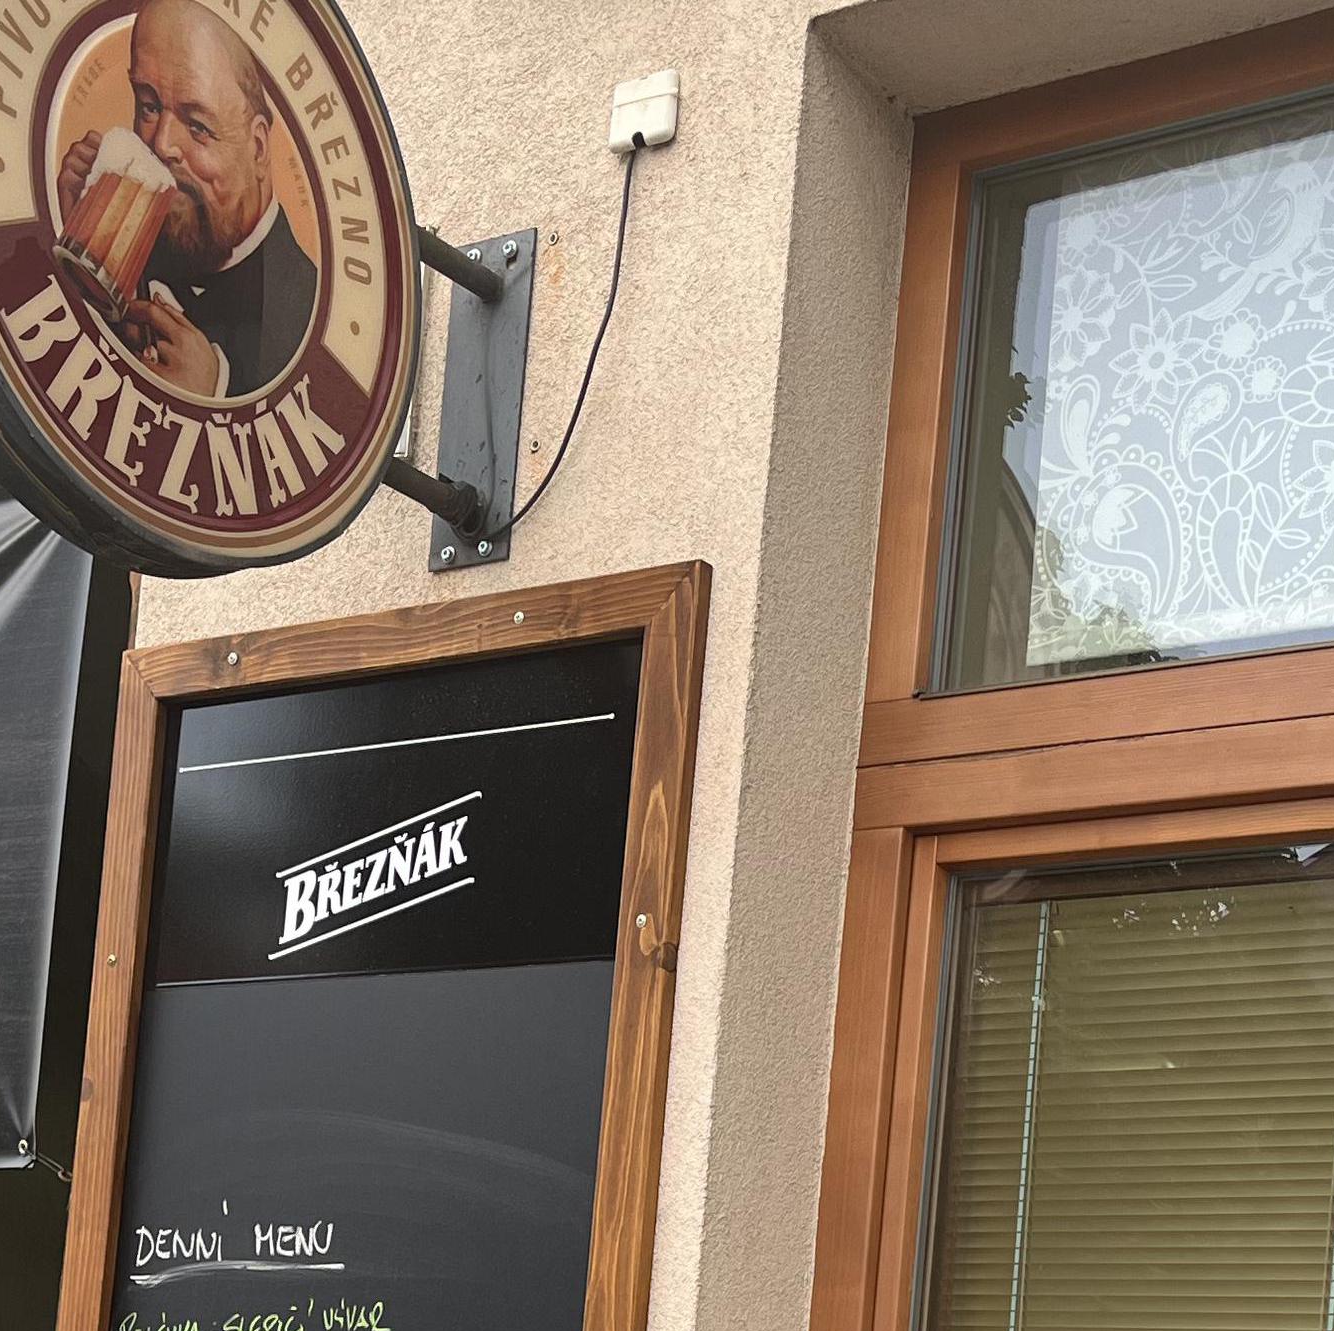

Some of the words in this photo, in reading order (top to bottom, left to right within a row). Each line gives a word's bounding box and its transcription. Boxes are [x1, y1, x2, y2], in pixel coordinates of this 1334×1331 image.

[285, 52, 372, 286] BŘEZNO
[0, 273, 346, 518] BŘEZŇÁK
[278, 815, 468, 945] BŘEZŇÁK
[135, 1199, 230, 1268] DENNÍ
[253, 1220, 335, 1257] MENU
